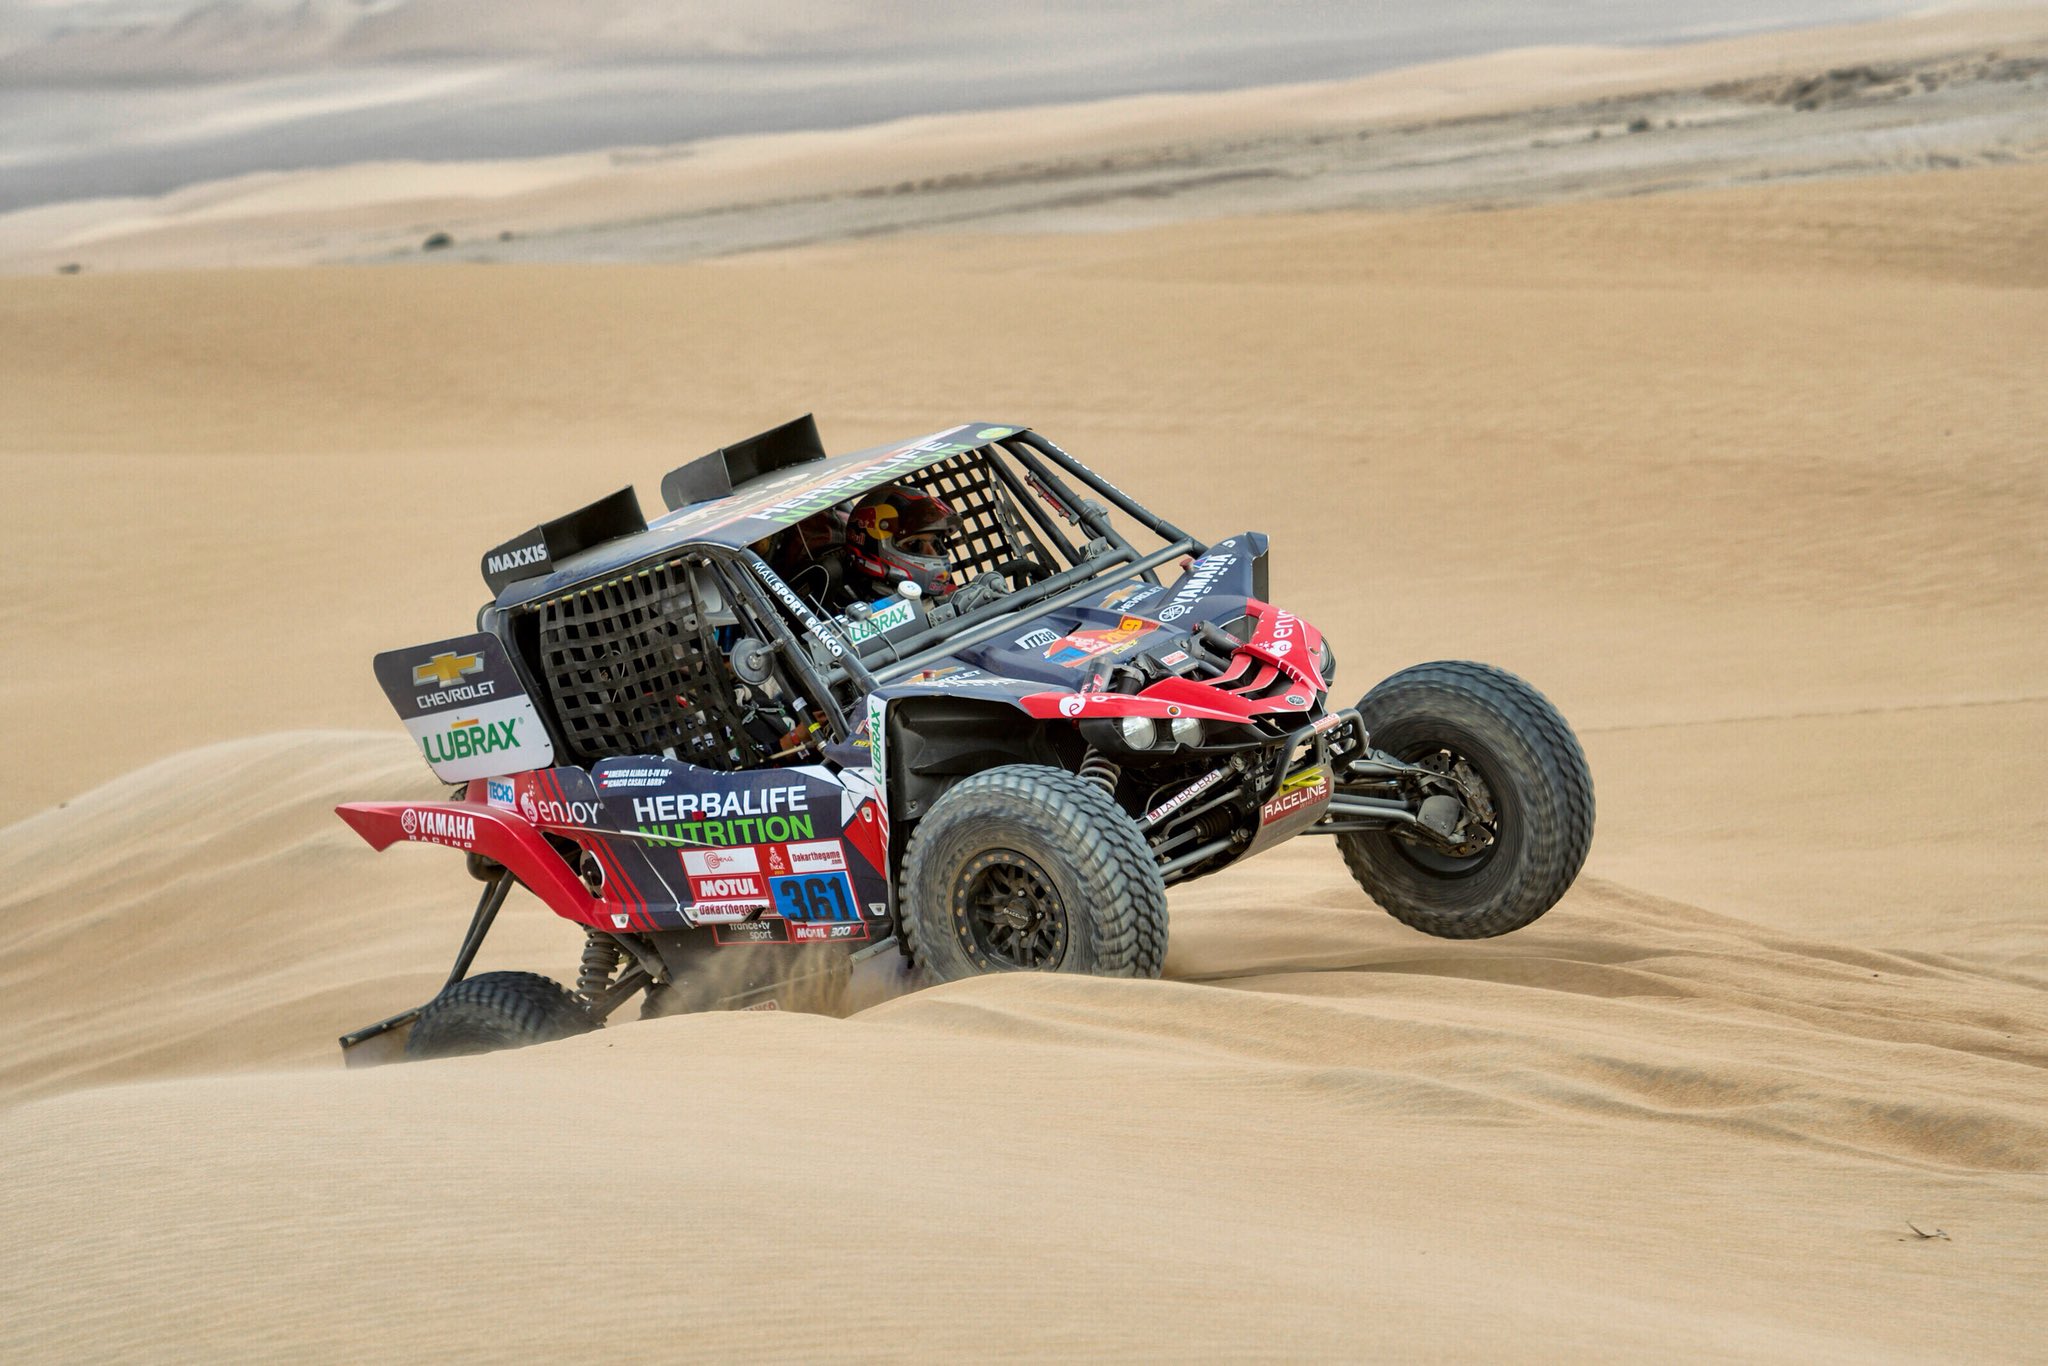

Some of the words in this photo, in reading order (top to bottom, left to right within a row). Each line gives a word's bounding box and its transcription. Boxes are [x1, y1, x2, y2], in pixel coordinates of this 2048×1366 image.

[747, 441, 952, 520] HERBALIFE
[772, 443, 971, 524] NUTRITION
[487, 543, 547, 575] MAXXIS
[1117, 584, 1164, 613] HEVROLET
[1169, 553, 1233, 607] YAMAHA
[752, 561, 807, 617] MALLSPORT
[804, 616, 843, 658] BAHCO
[416, 680, 496, 710] CHEVROLET
[422, 718, 522, 765] LUBRAX
[869, 704, 883, 786] LUBRAX
[488, 781, 514, 804] TECHO
[633, 785, 809, 823] HERBALIFE
[1264, 780, 1327, 819] RACELINE
[418, 811, 476, 840] YAMAHA
[638, 814, 815, 848] NUTRITION
[700, 878, 759, 898] MOTUL
[780, 876, 851, 923] 361
[749, 930, 773, 942] sport
